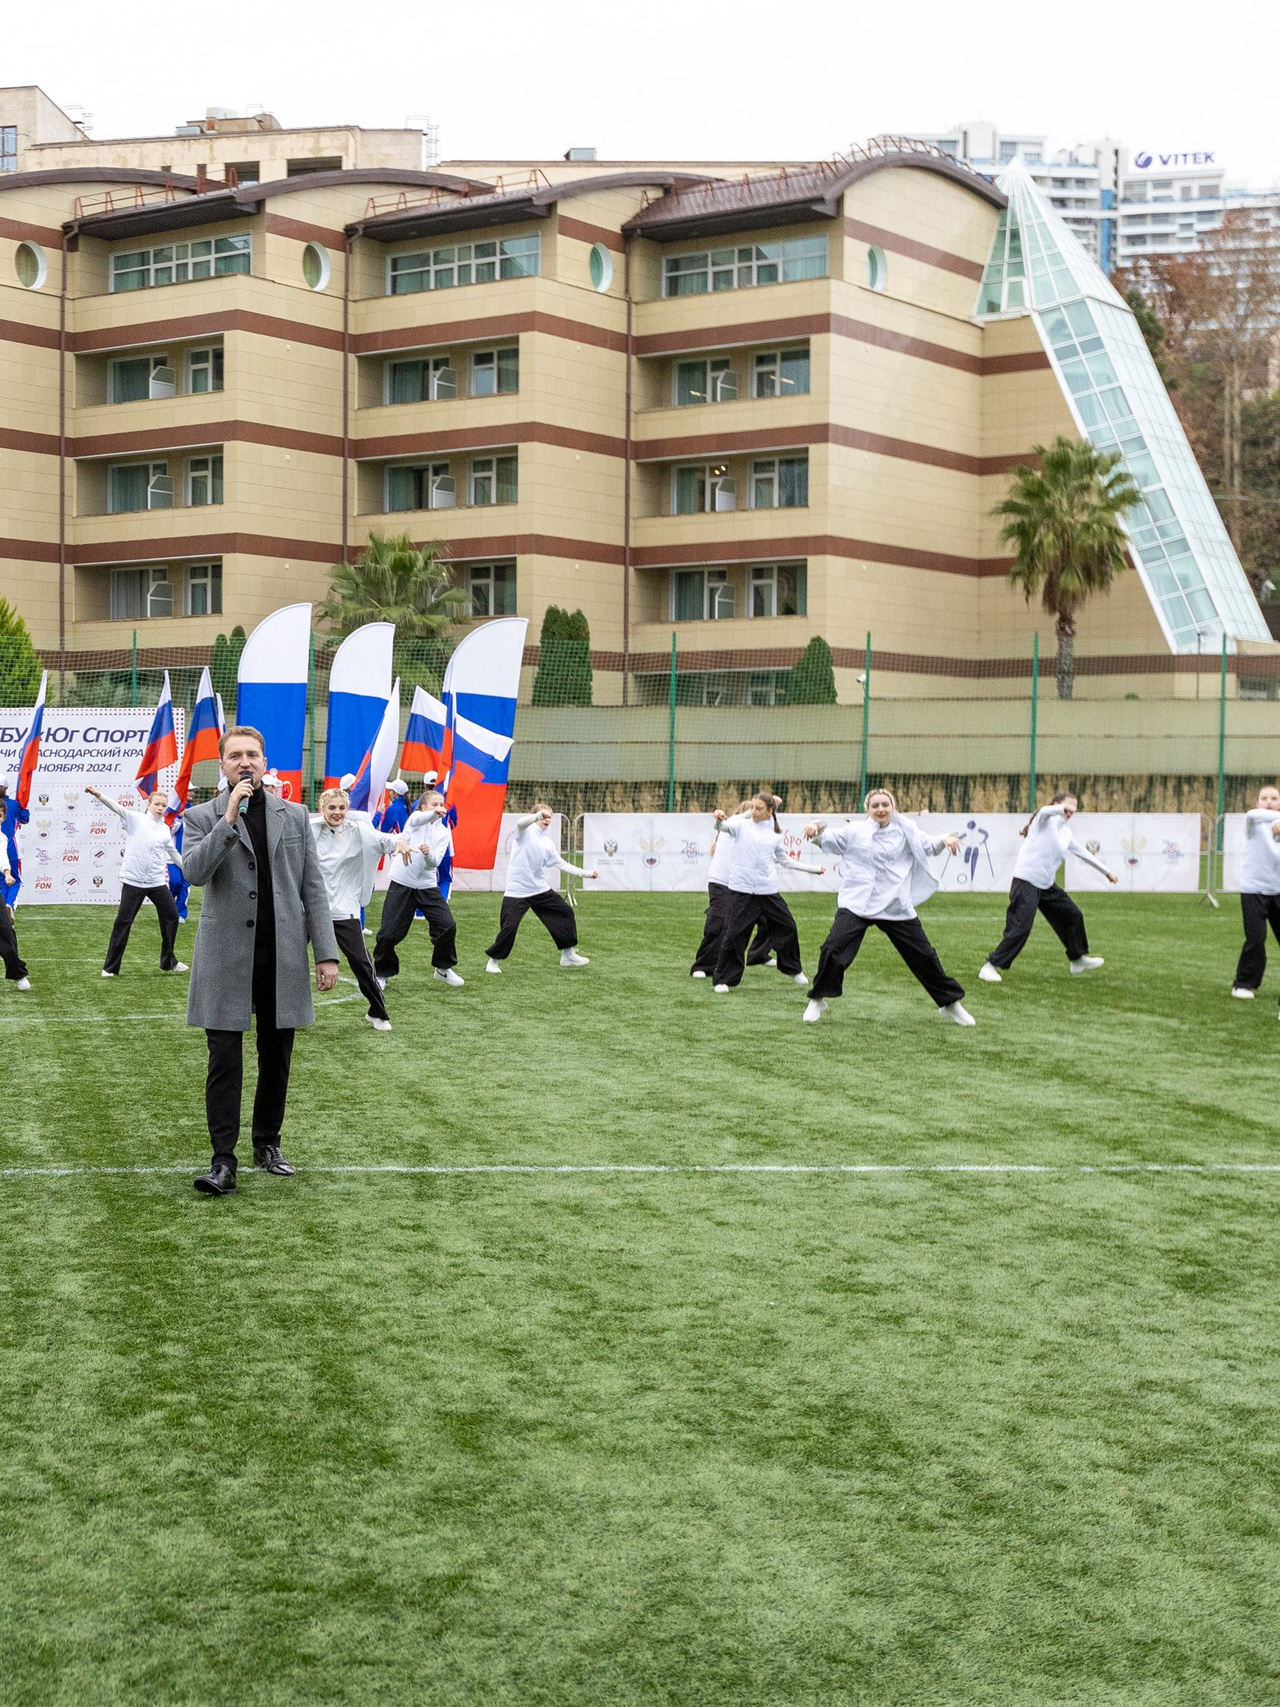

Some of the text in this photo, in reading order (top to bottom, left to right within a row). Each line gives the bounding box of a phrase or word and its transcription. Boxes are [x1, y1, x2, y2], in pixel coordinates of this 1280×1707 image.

[1159, 152, 1215, 165] VITEK
[6, 763, 20, 773] 26
[38, 763, 84, 772] НОЯБРЯ
[86, 763, 112, 772] 2024
